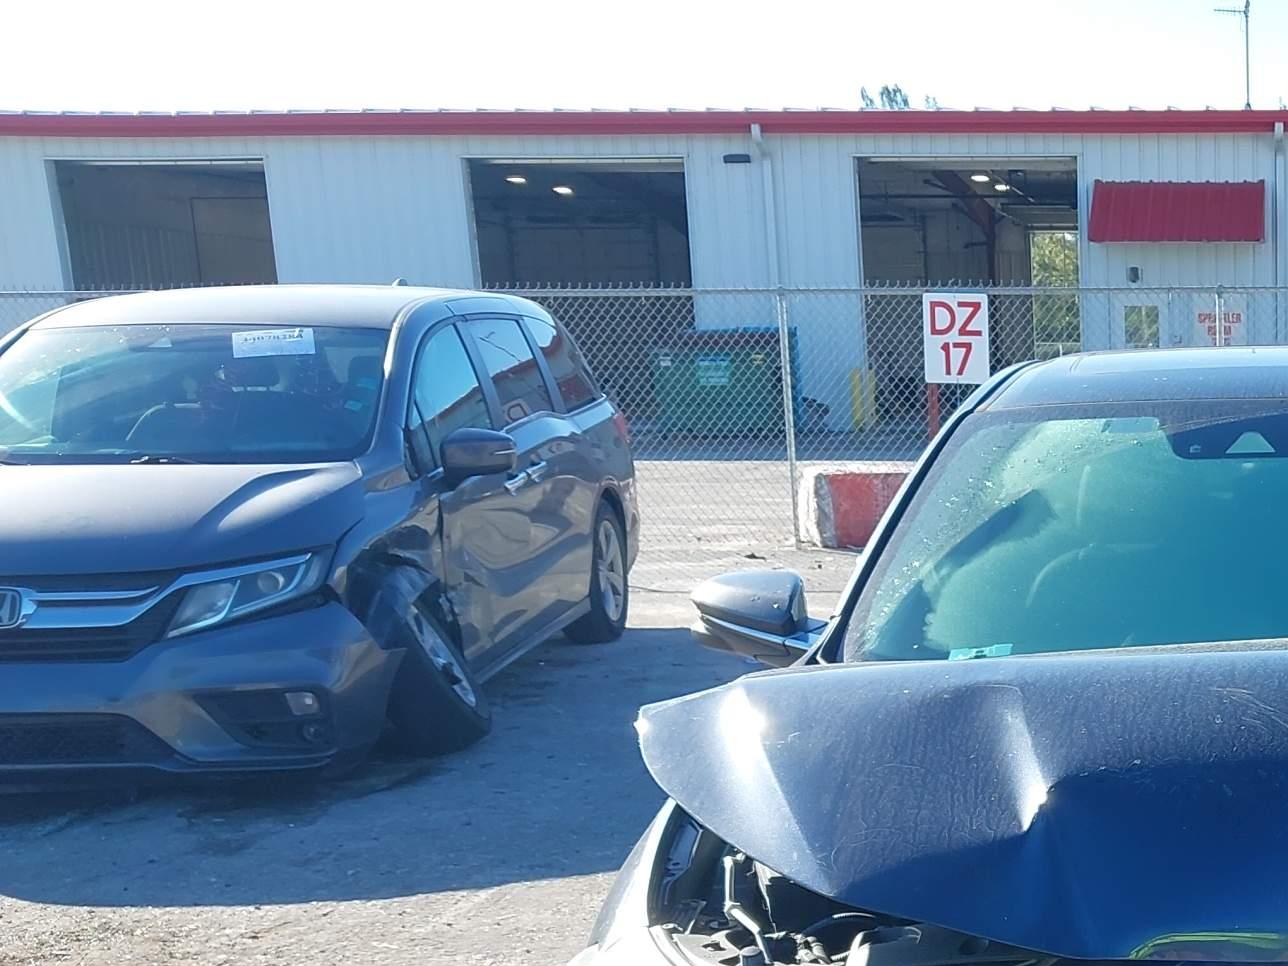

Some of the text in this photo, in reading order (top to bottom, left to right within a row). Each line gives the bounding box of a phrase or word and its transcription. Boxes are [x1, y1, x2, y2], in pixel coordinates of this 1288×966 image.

[929, 300, 982, 336] DZ
[1197, 312, 1242, 323] SPRILER
[940, 342, 972, 376] 17
